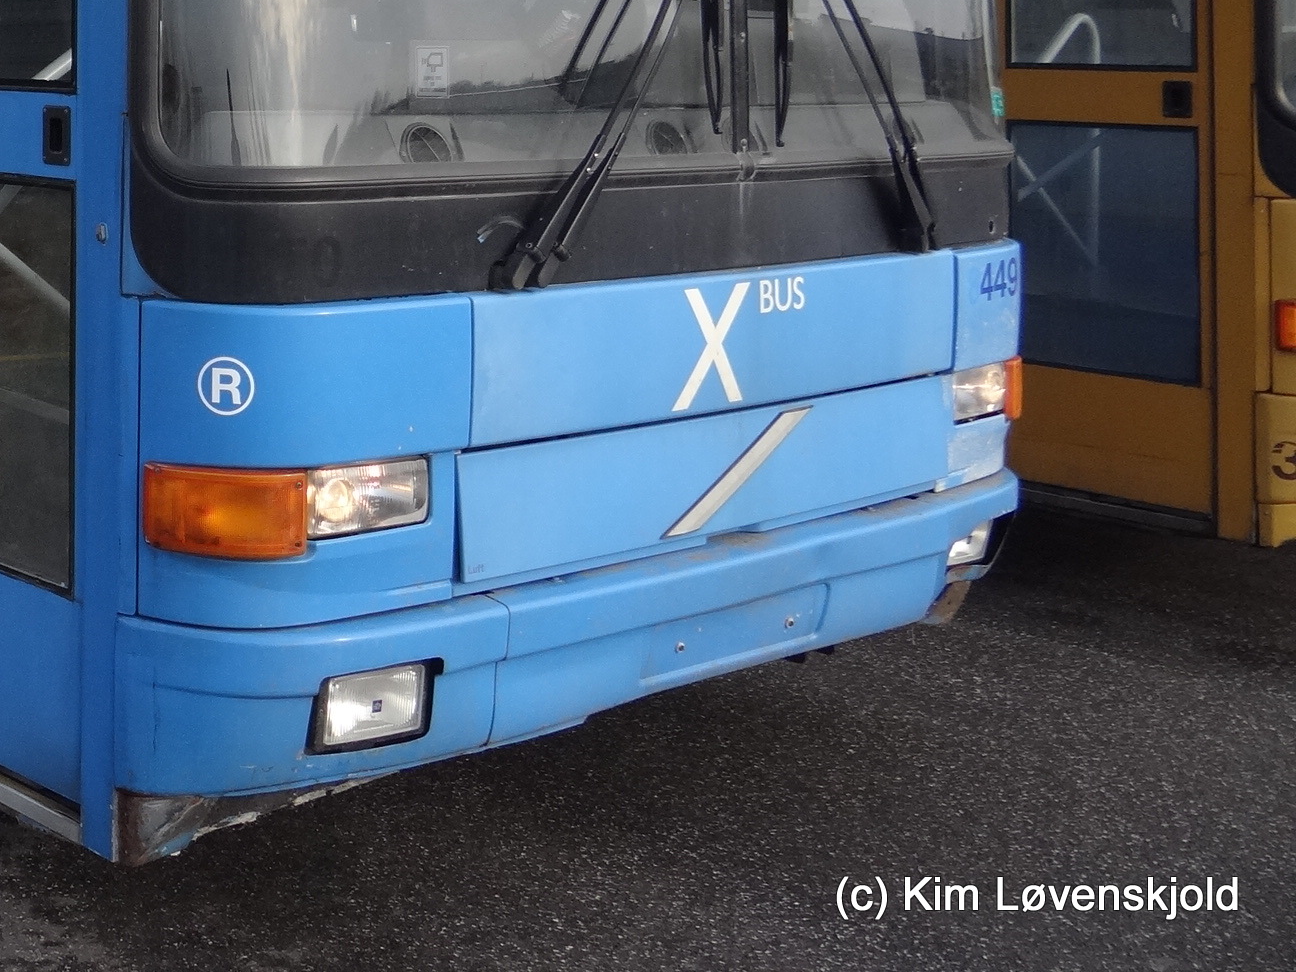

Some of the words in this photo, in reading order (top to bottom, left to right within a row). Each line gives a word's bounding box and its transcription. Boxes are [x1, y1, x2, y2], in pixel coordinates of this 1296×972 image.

[980, 257, 1018, 302] 449
[671, 281, 751, 412] X
[759, 276, 805, 314] BUS
